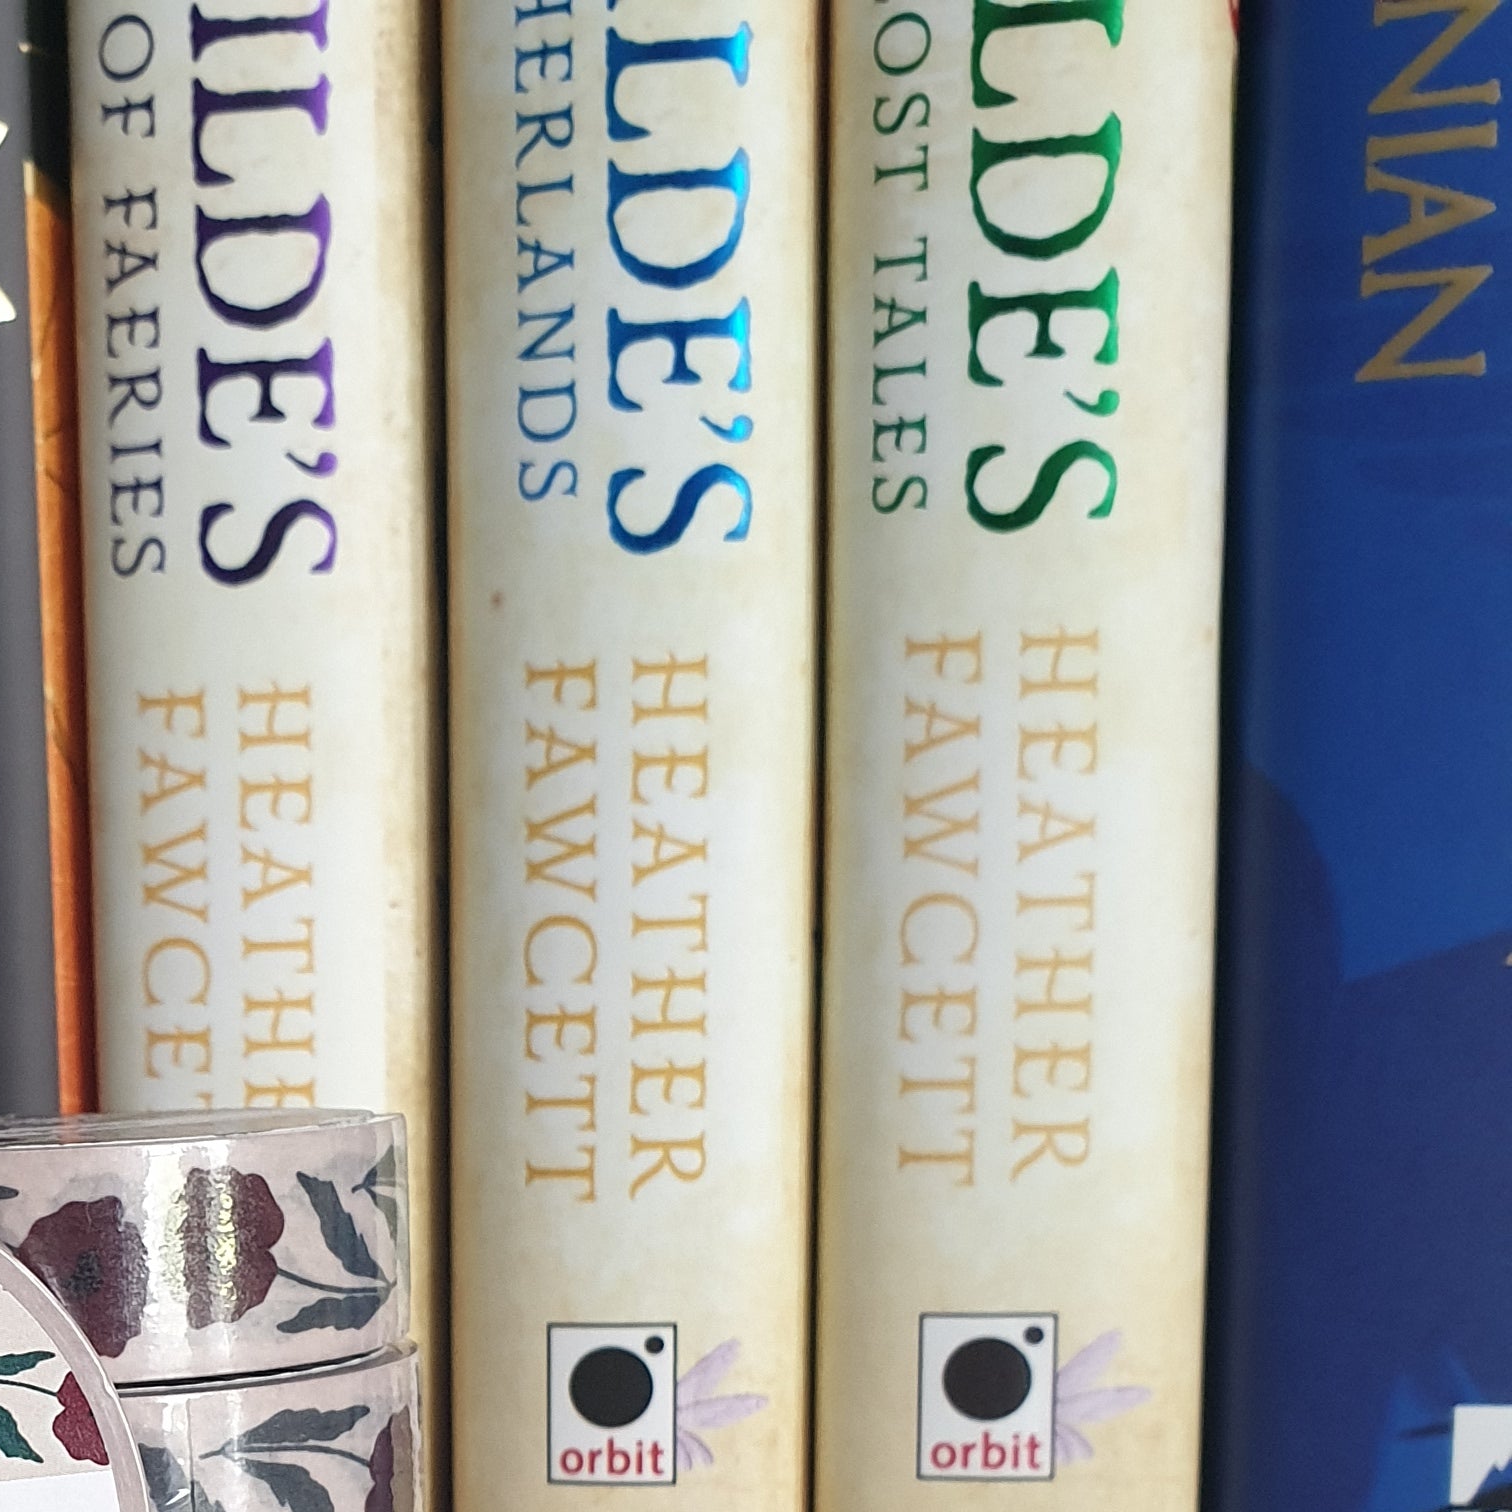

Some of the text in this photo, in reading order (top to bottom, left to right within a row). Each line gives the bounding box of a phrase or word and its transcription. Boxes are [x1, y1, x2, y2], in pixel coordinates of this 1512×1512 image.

[97, 14, 166, 579] OF FAERIES
[604, 0, 754, 556] LDE'S
[871, 0, 932, 516] OST TALES
[140, 687, 214, 1110] FAWCE
[238, 681, 316, 1108] HEATHE
[523, 658, 599, 1202] FAWCETT
[630, 651, 710, 1199] HEATHER
[897, 630, 983, 1187] FAWCETT
[1011, 625, 1100, 1183] HEATHER
[559, 1438, 664, 1477] orbit
[929, 1432, 1042, 1472] orbit
